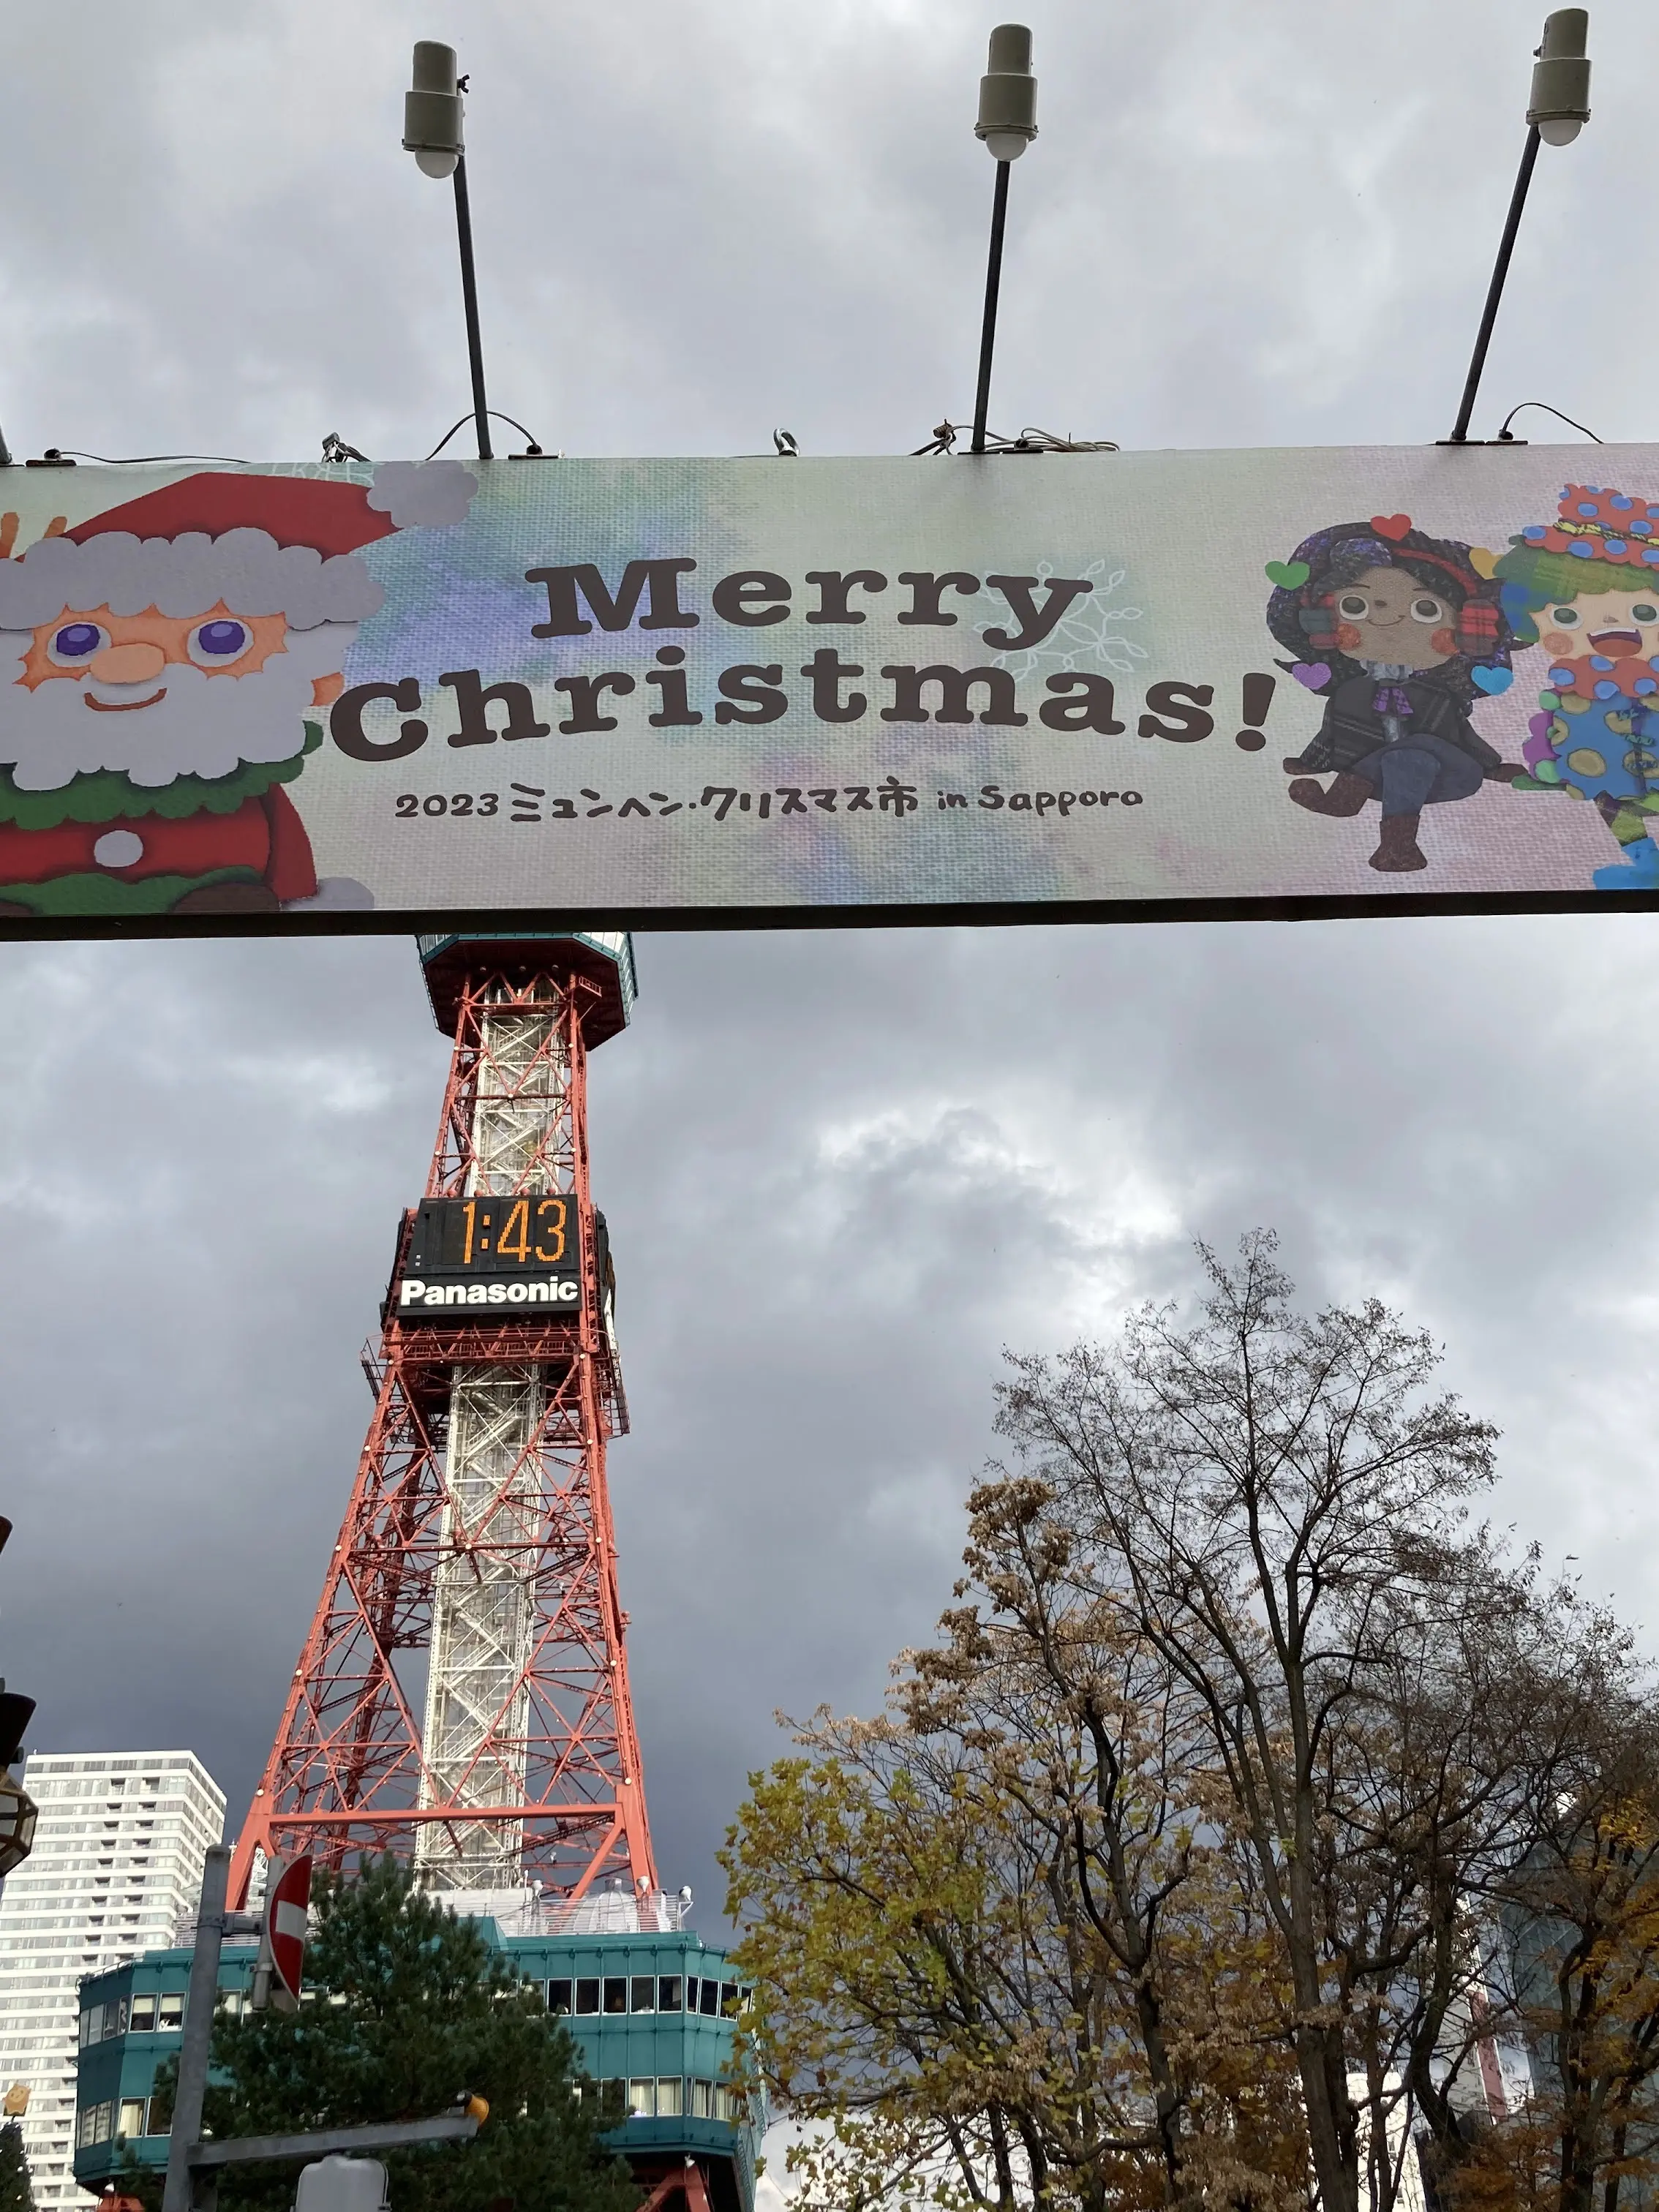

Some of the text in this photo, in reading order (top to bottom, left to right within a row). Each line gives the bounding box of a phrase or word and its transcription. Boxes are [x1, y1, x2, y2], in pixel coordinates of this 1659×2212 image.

[524, 557, 1094, 659] Merry
[329, 646, 1276, 762] Christmas!
[937, 790, 968, 810] in
[977, 785, 1143, 817] Sapporo
[462, 1199, 567, 1263] 1:43
[400, 1275, 579, 1306] Panasonic
